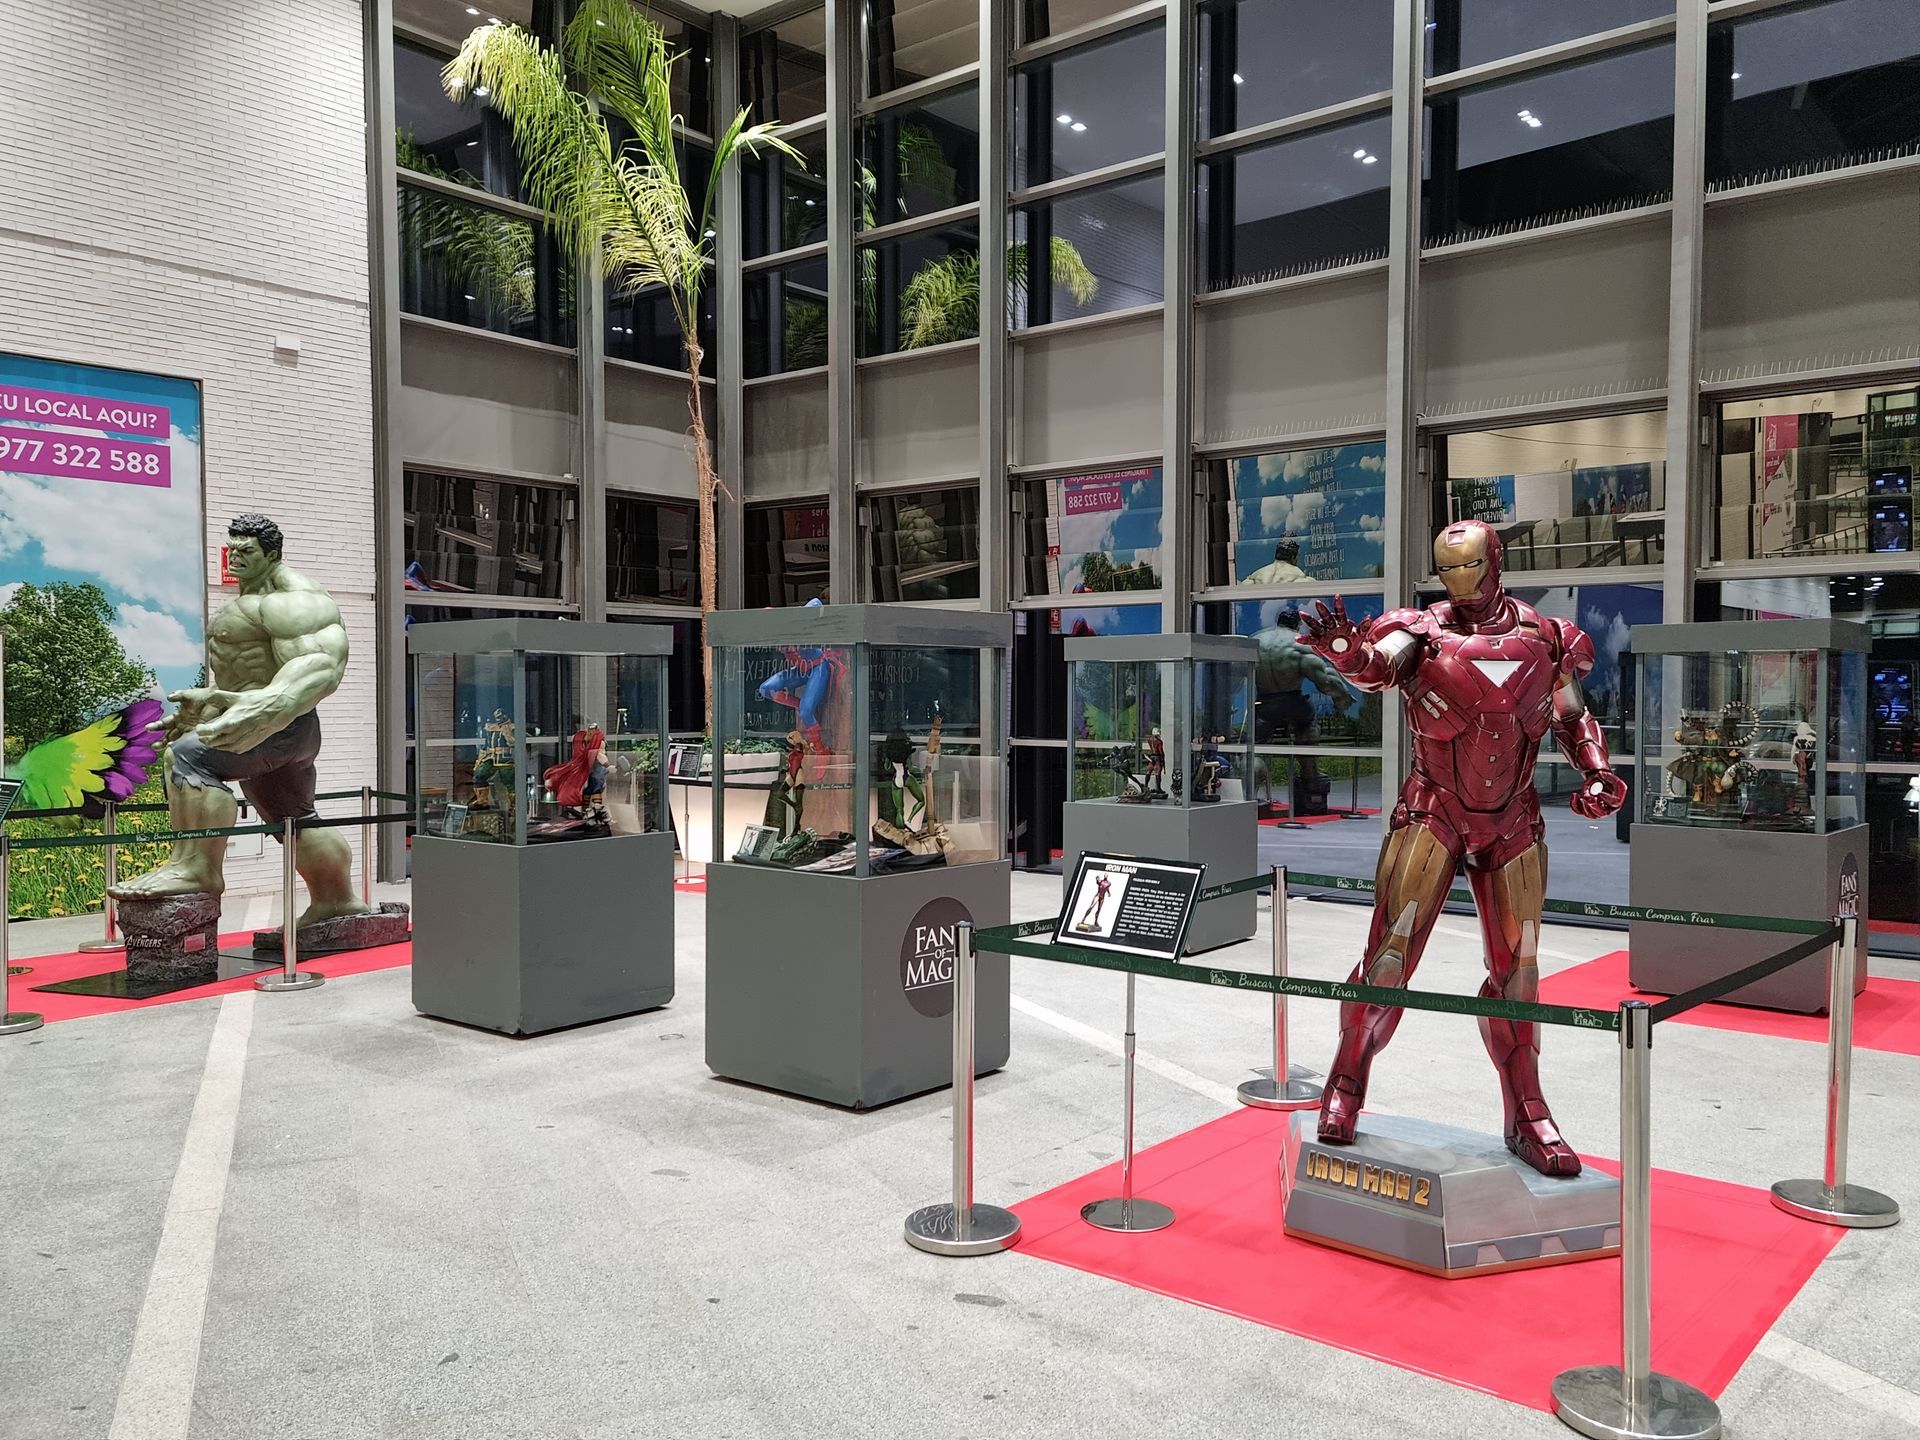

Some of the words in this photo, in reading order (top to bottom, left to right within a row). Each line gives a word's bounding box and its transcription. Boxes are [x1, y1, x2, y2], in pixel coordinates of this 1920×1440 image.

[24, 397, 93, 421] LOCAL
[96, 407, 158, 429] AQUI?
[0, 436, 45, 462] 977
[52, 443, 102, 469] 322
[110, 449, 160, 475] 588
[1105, 863, 1121, 872] IRON
[1121, 865, 1138, 874] MAN
[1690, 912, 1716, 925] Firar
[127, 935, 162, 948] AVENGERS
[914, 925, 955, 954] FAN
[934, 948, 946, 959] OF
[905, 957, 953, 987] MAG
[1330, 981, 1359, 999] Firar
[1574, 1017, 1595, 1027] FIRA
[1306, 1149, 1361, 1188] IRON
[1362, 1163, 1412, 1201] MAN
[1414, 1176, 1431, 1206] 2
